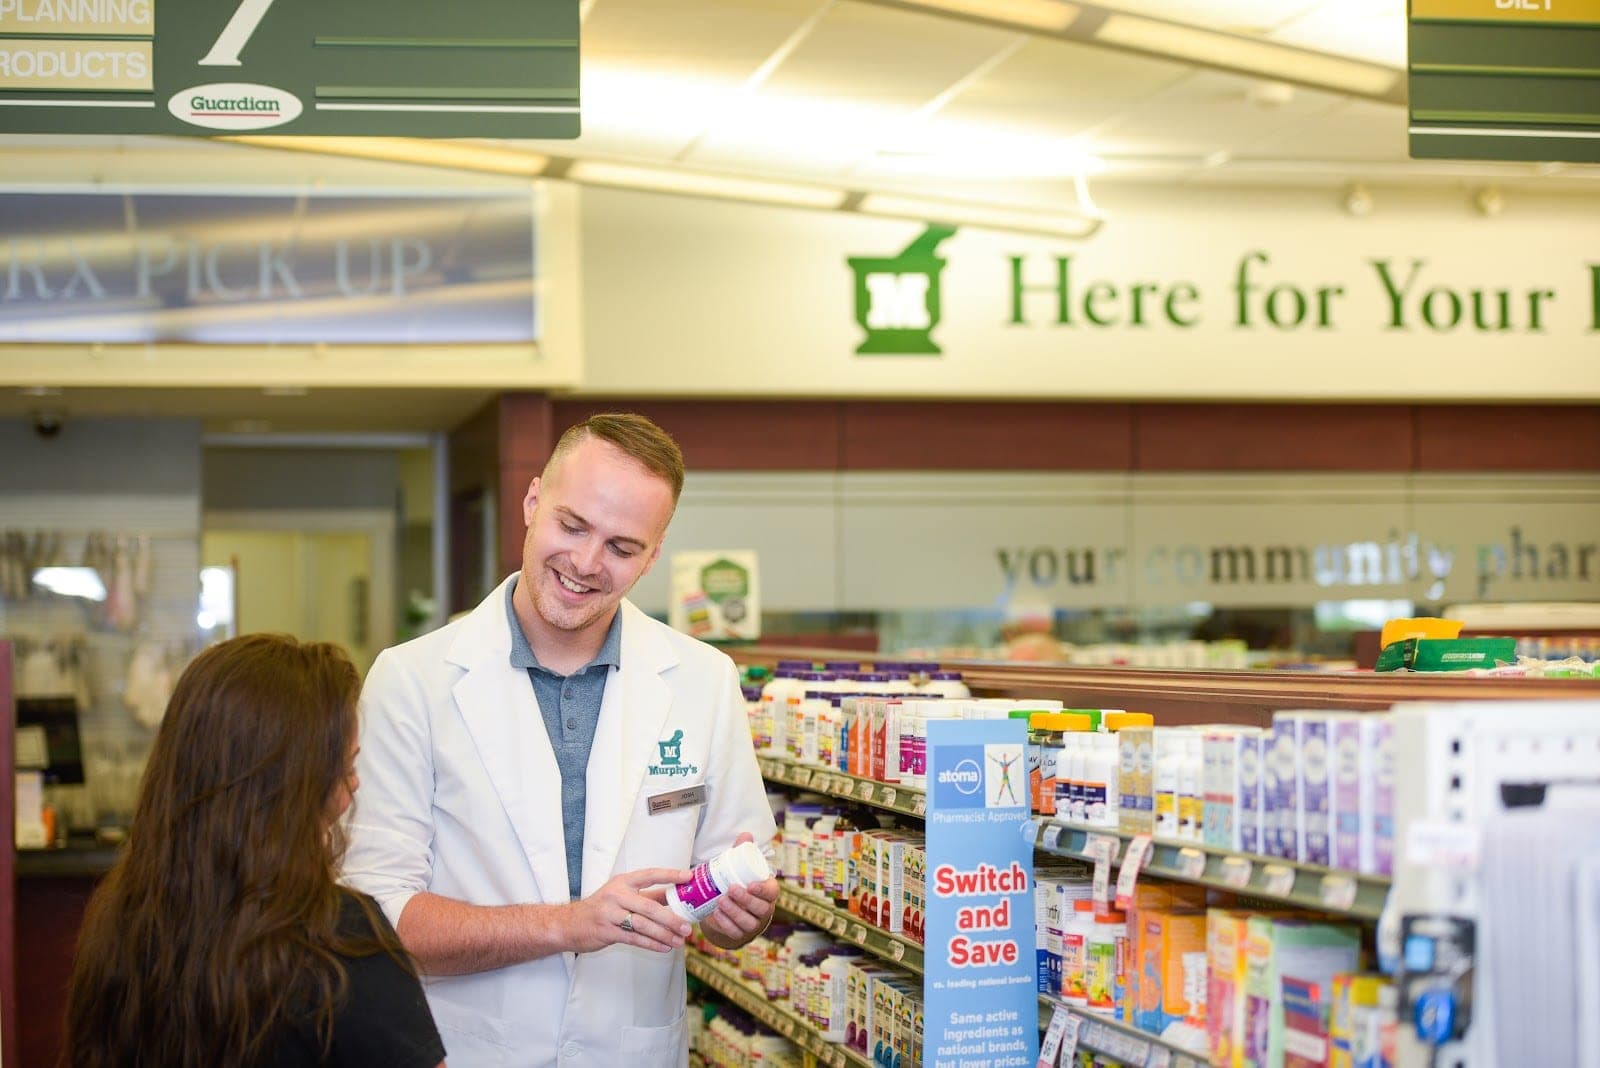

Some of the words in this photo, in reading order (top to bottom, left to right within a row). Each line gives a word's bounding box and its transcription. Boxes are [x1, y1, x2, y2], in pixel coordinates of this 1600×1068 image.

[190, 96, 280, 112] Guardian
[7, 237, 105, 299] RX
[136, 238, 303, 299] PICK
[335, 236, 432, 299] UP
[1006, 254, 1202, 327] Here
[1232, 250, 1345, 331] for
[1370, 258, 1556, 332] Your
[994, 545, 1127, 604] your
[1144, 528, 1455, 601] community
[664, 746, 677, 758] M
[648, 764, 698, 776] Murphy's
[938, 769, 978, 783] atoma
[932, 810, 985, 823] Pharmacist
[987, 810, 1028, 822] Approved
[935, 863, 1026, 895] Switch
[957, 900, 1009, 929] and
[950, 937, 1017, 966] Save
[947, 979, 977, 989] leading
[978, 977, 1007, 986] national
[1008, 976, 1032, 985] brands
[950, 1012, 983, 1024] Same
[985, 1009, 1018, 1022] active
[943, 1026, 1009, 1041] ingredients
[1011, 1026, 1024, 1036] as
[937, 1042, 985, 1056] national
[988, 1040, 1028, 1053] brands,
[935, 1059, 956, 1068] but
[959, 1058, 991, 1068] lower
[994, 1055, 1029, 1068] prices.
